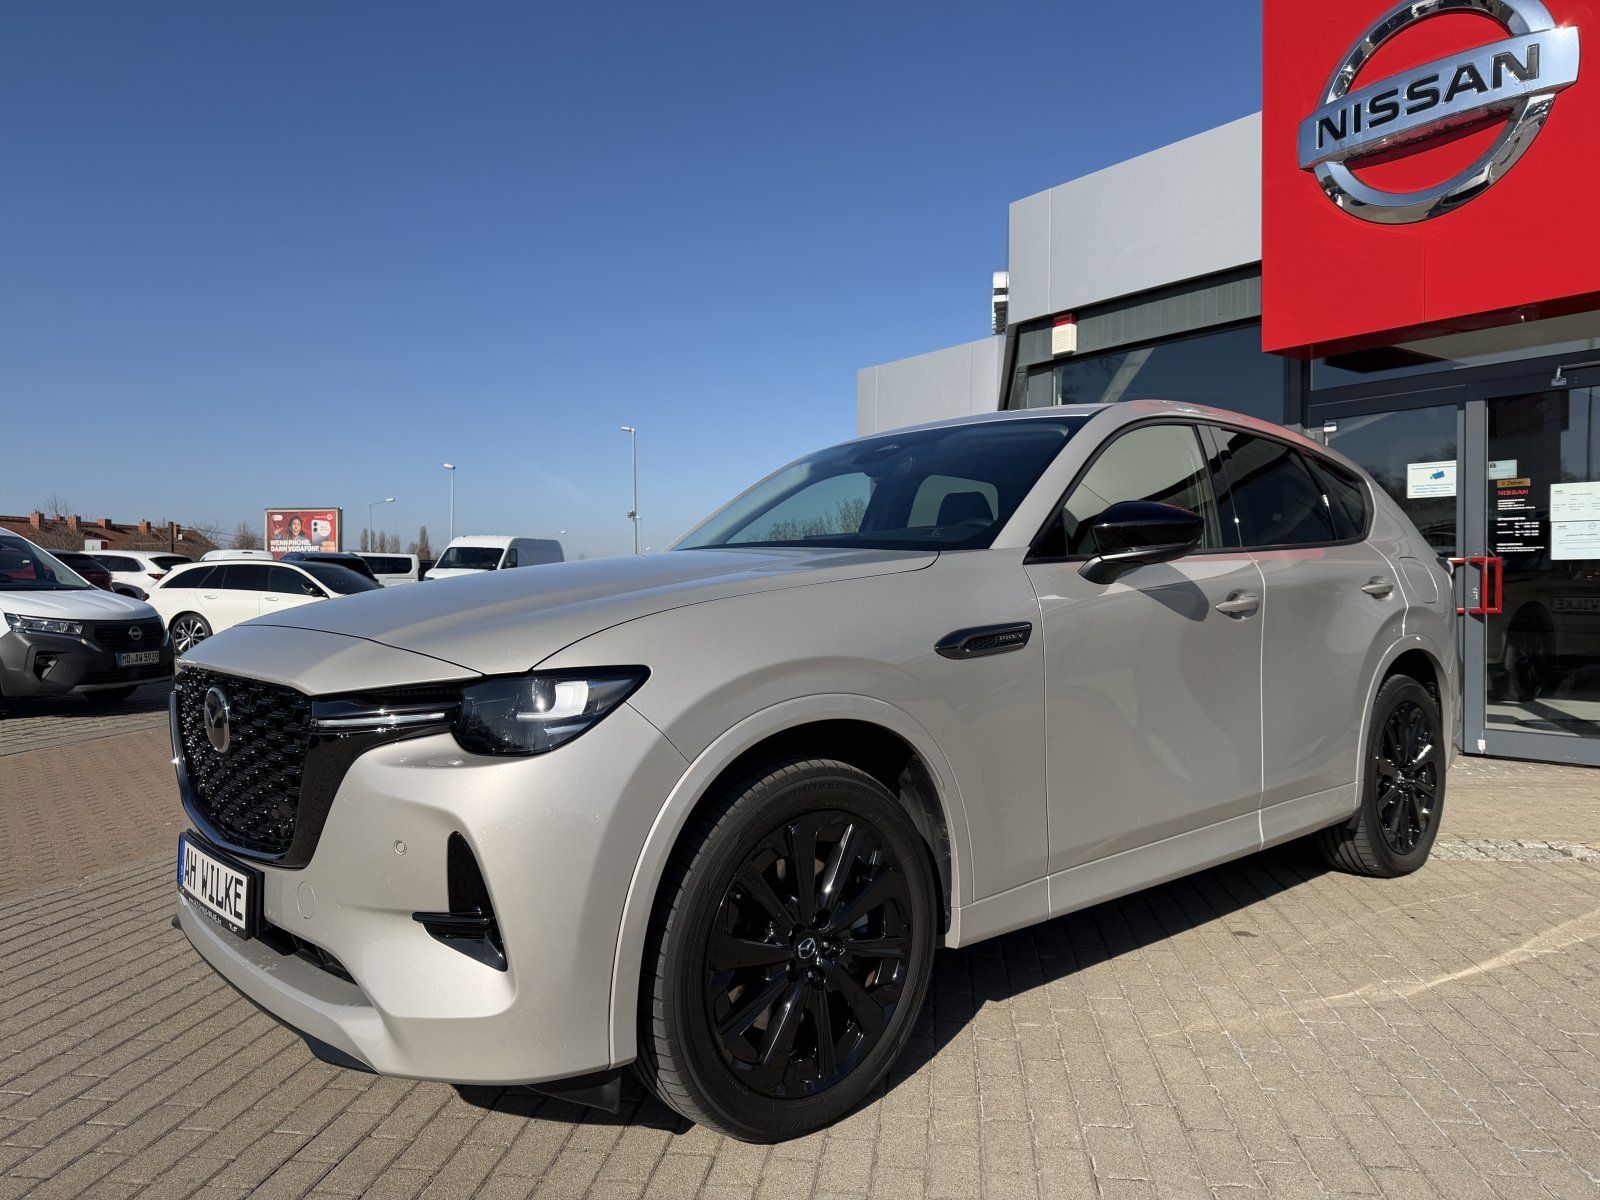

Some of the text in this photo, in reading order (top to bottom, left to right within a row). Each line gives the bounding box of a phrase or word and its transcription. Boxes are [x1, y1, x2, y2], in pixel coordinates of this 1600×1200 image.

[1315, 43, 1540, 150] NISSAN
[184, 847, 197, 890] AH
[201, 858, 244, 921] WILKE
